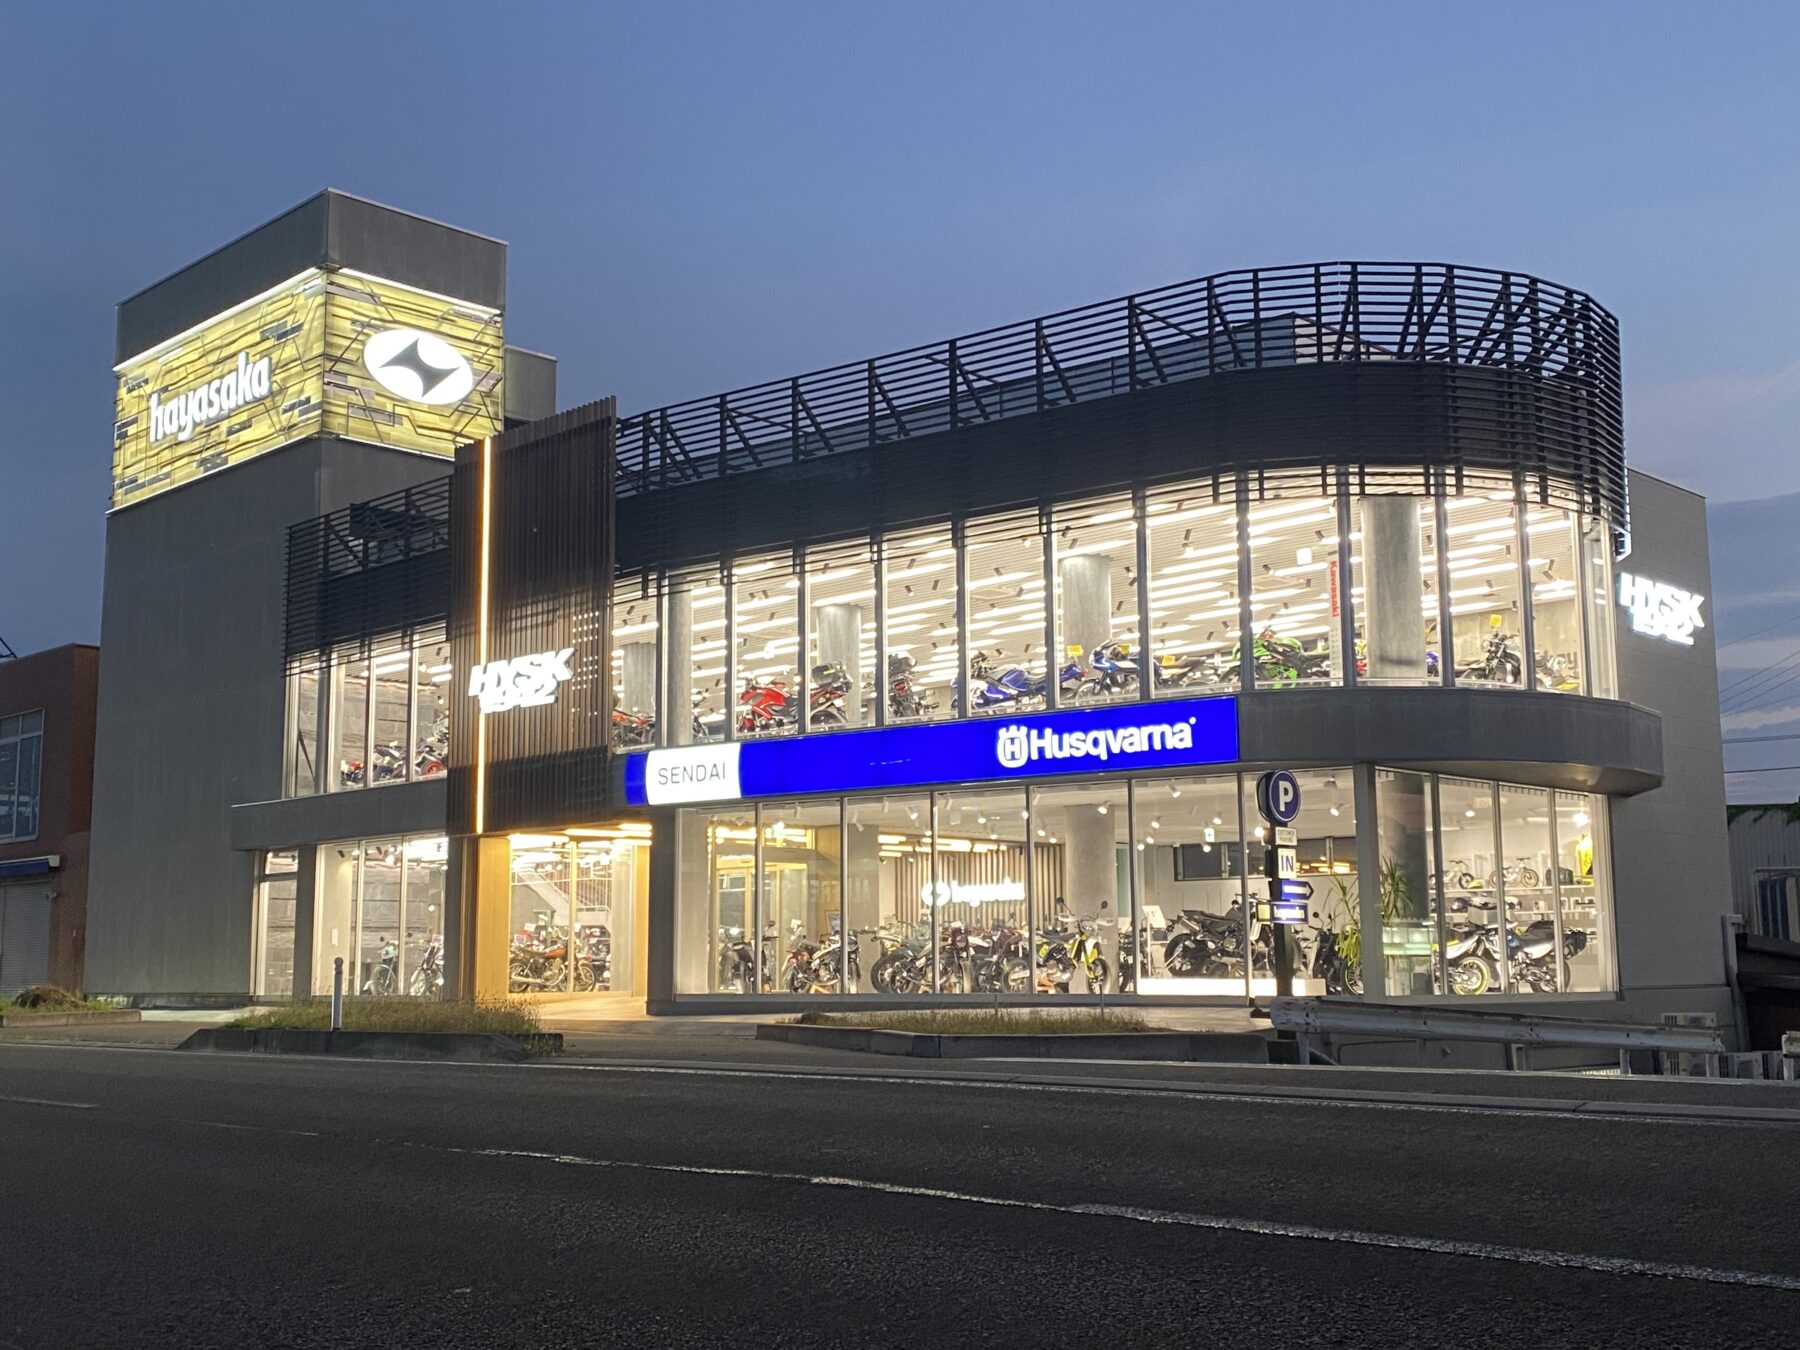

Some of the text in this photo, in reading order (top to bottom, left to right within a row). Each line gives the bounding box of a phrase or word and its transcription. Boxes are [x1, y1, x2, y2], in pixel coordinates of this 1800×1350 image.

[149, 351, 273, 443] hayasaka
[1330, 560, 1340, 617] Kawasaki
[1030, 722, 1194, 761] Husqvarna
[658, 762, 725, 785] SENDAI
[1279, 780, 1294, 812] P
[1280, 855, 1295, 873] IN
